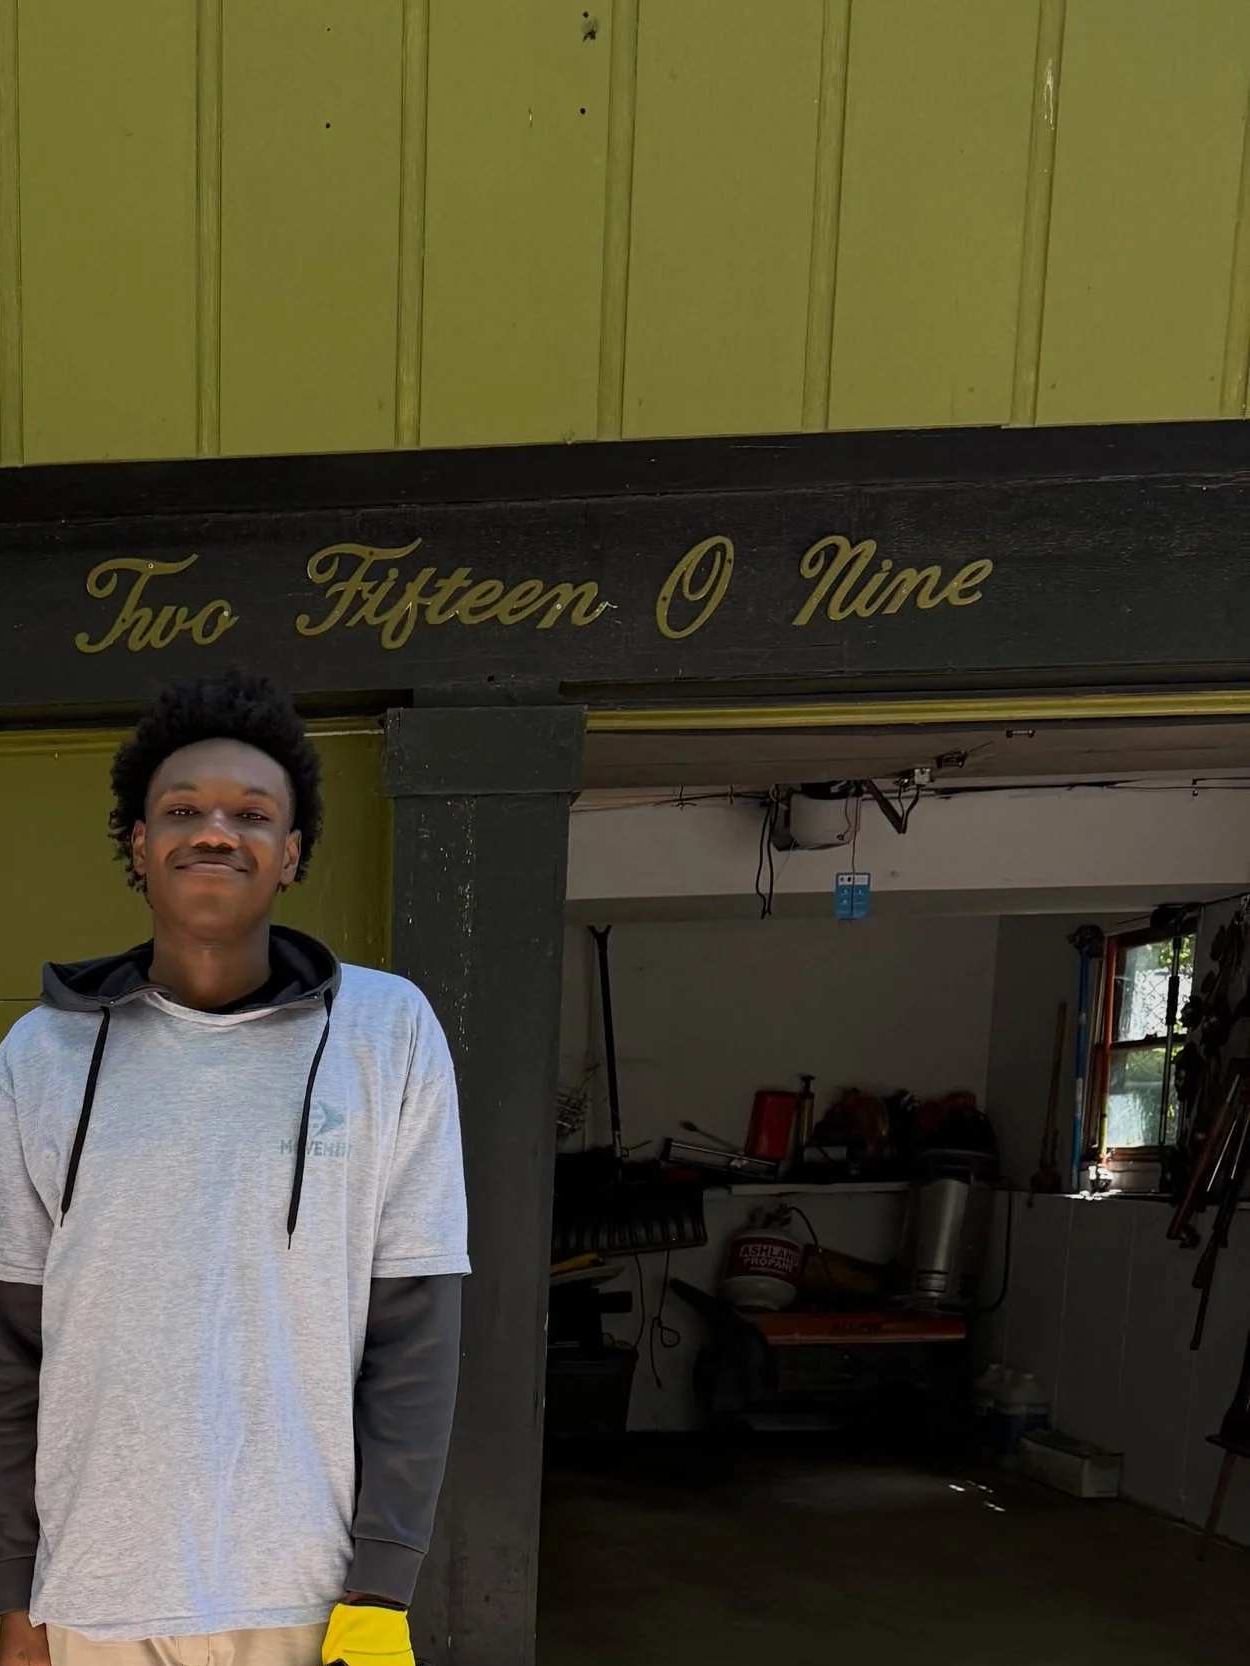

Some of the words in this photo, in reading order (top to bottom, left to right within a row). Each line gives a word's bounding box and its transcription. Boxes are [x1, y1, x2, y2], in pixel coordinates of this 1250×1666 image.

[75, 553, 239, 655] Two
[296, 537, 606, 651] Fifteen
[655, 535, 735, 640] O
[793, 535, 993, 627] Nine
